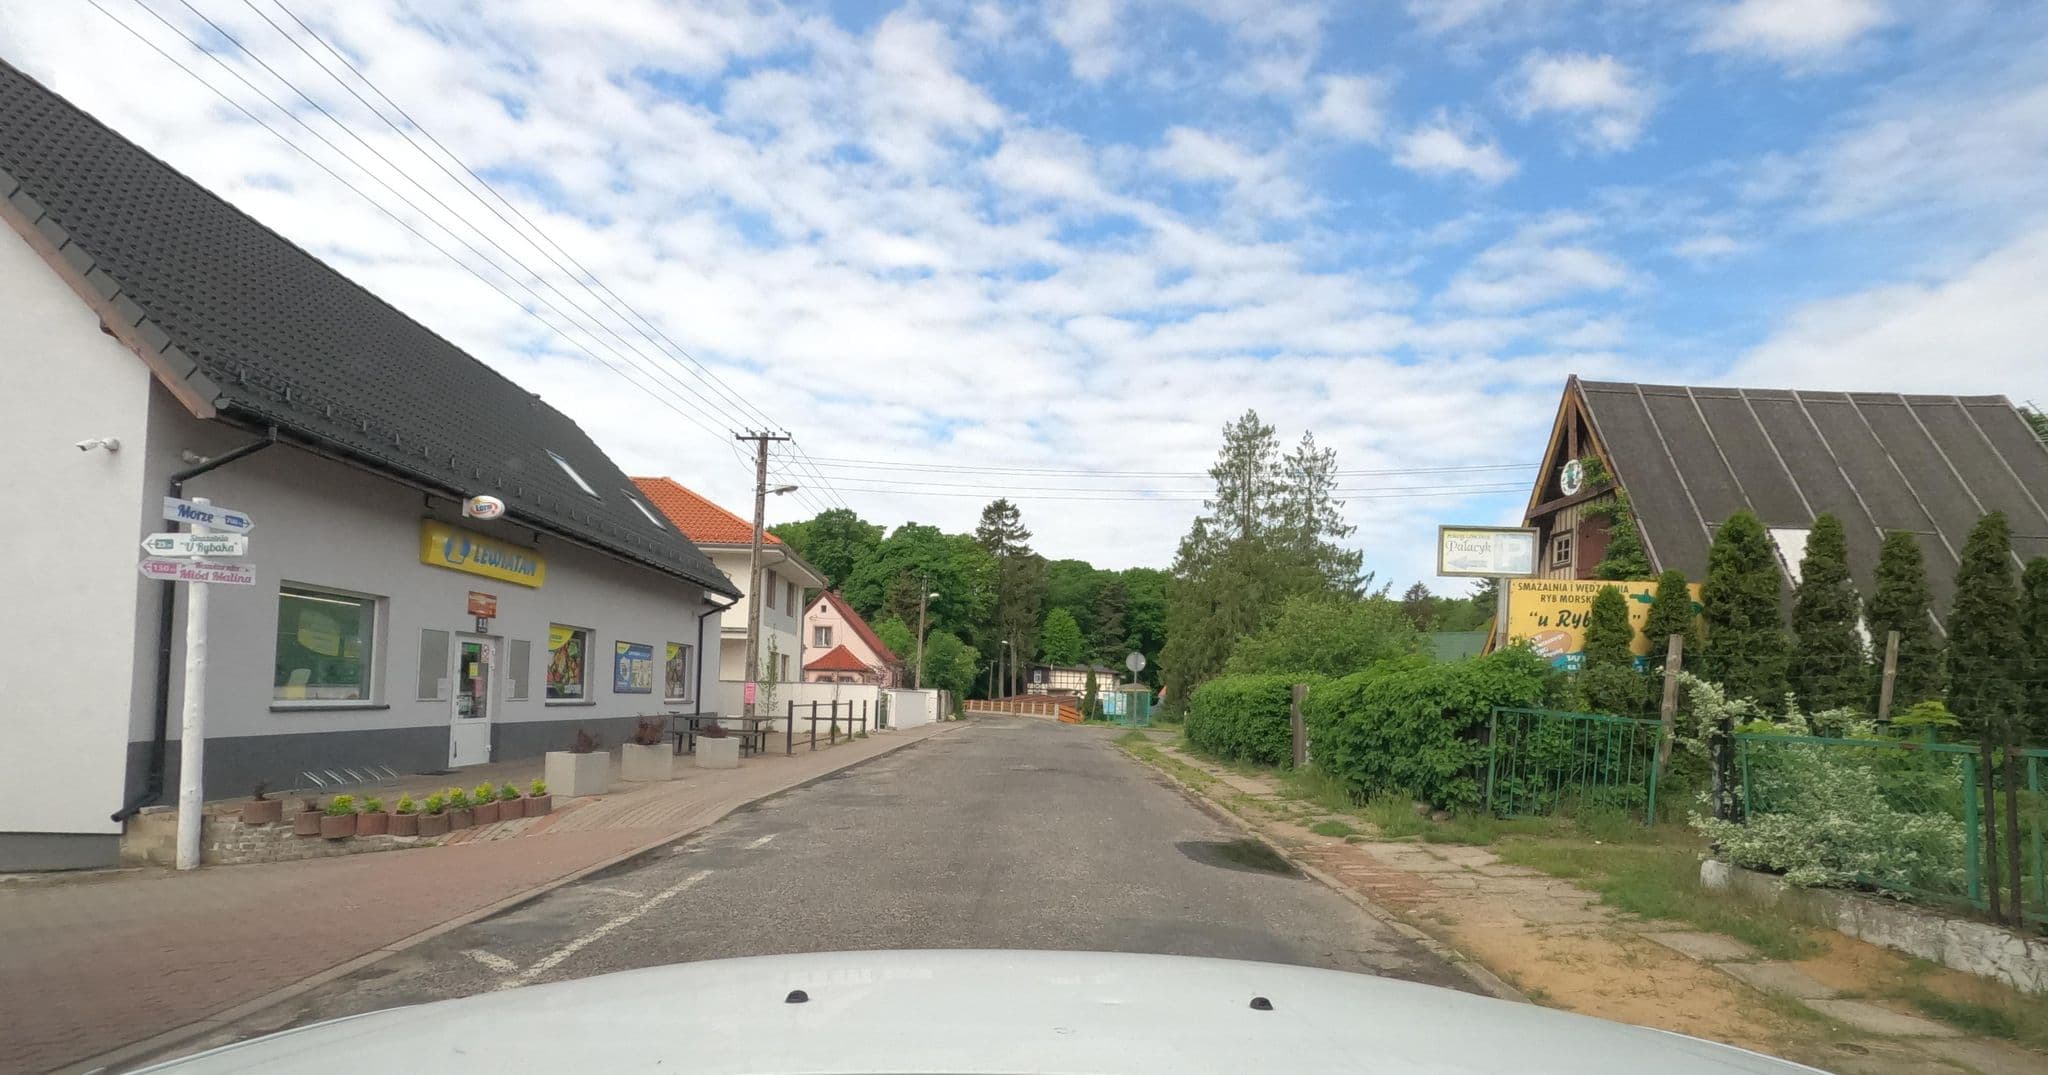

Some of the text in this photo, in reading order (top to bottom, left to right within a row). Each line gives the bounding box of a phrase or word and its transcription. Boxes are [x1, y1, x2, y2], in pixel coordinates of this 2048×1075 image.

[177, 504, 214, 523] Morze
[212, 571, 252, 584] Malina
[1540, 594, 1557, 603] RYB
